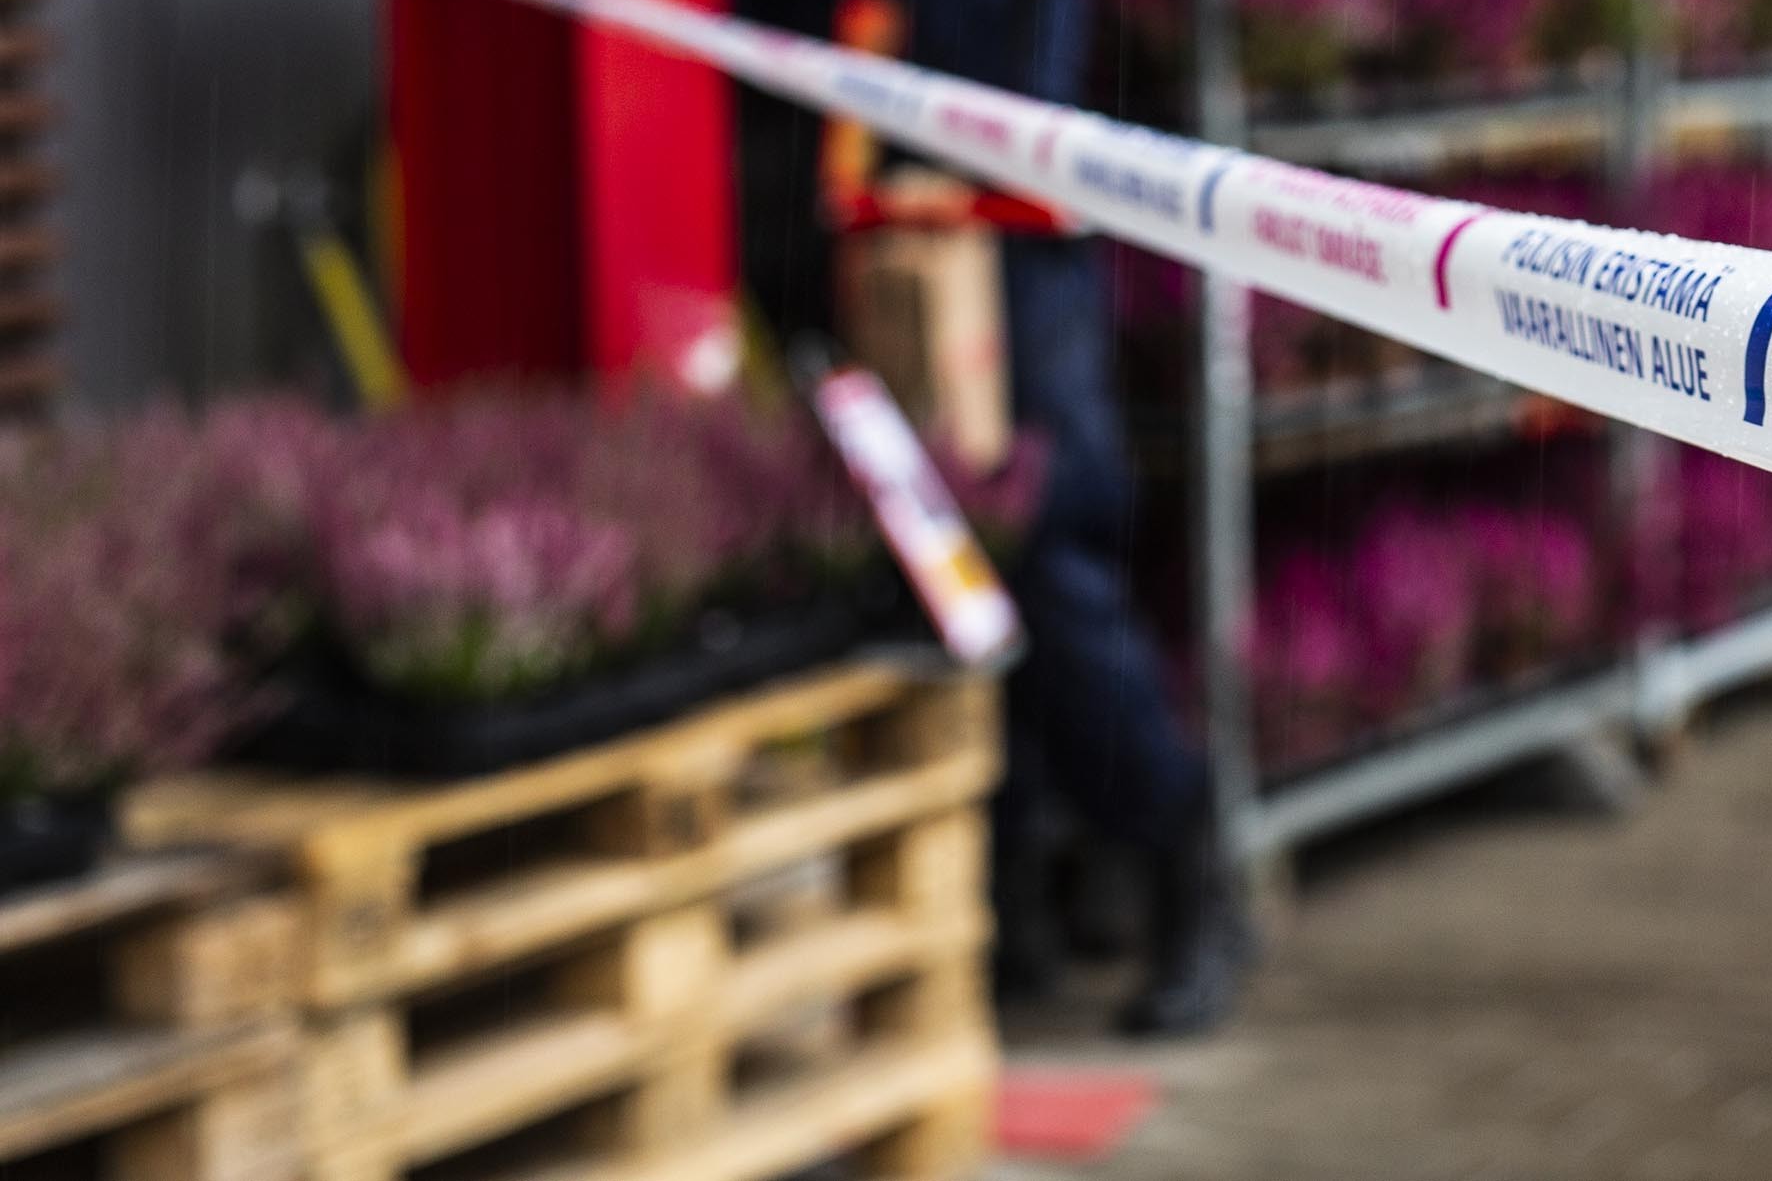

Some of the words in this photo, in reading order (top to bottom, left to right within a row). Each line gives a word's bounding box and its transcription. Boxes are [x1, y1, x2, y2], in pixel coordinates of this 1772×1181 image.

[1593, 248, 1735, 323] ERISTÄMÄ
[1494, 287, 1645, 379] VAARALLINEN
[1652, 333, 1712, 403] ALUE
